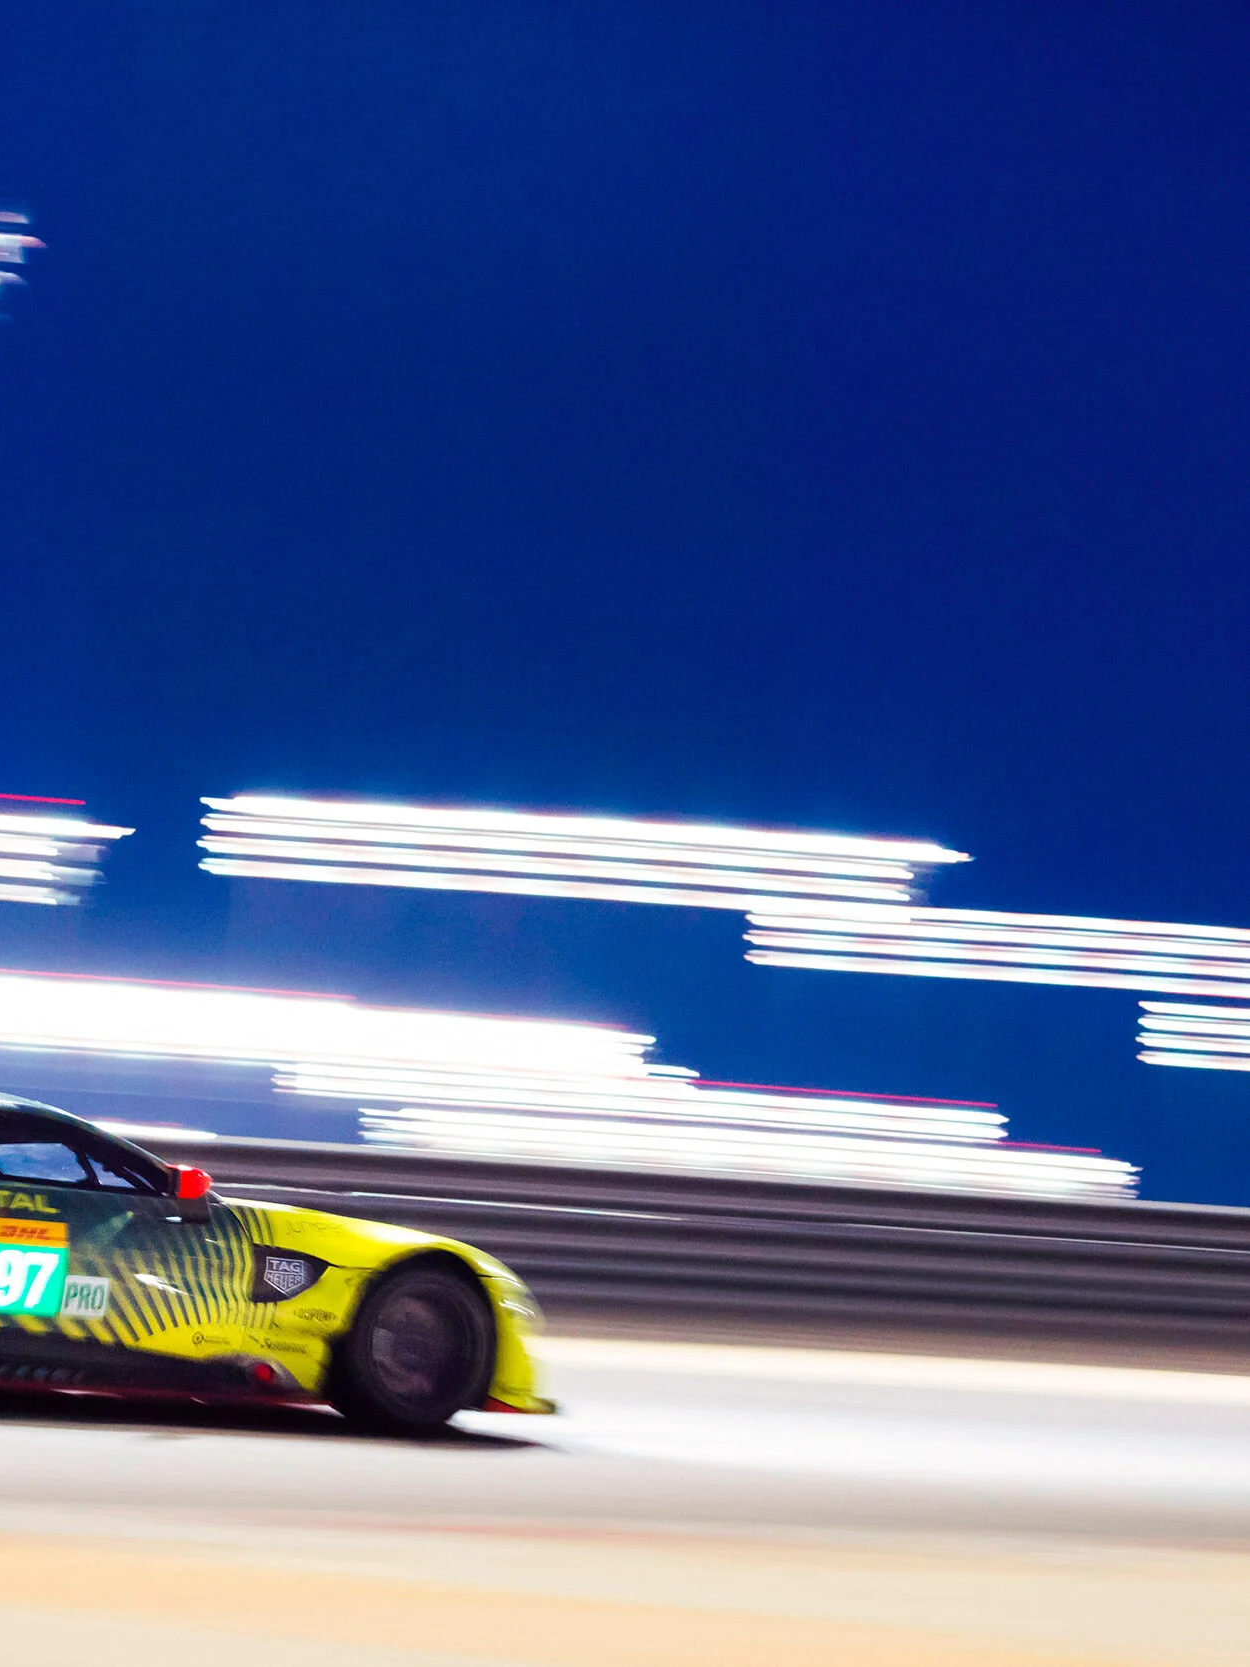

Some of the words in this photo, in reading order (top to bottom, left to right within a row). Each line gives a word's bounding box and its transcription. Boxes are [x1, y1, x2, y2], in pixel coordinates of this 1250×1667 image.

[0, 1225, 50, 1240] DHL
[269, 1260, 301, 1273] TAG
[266, 1272, 303, 1291] HEUER
[64, 1282, 105, 1310] PRO
